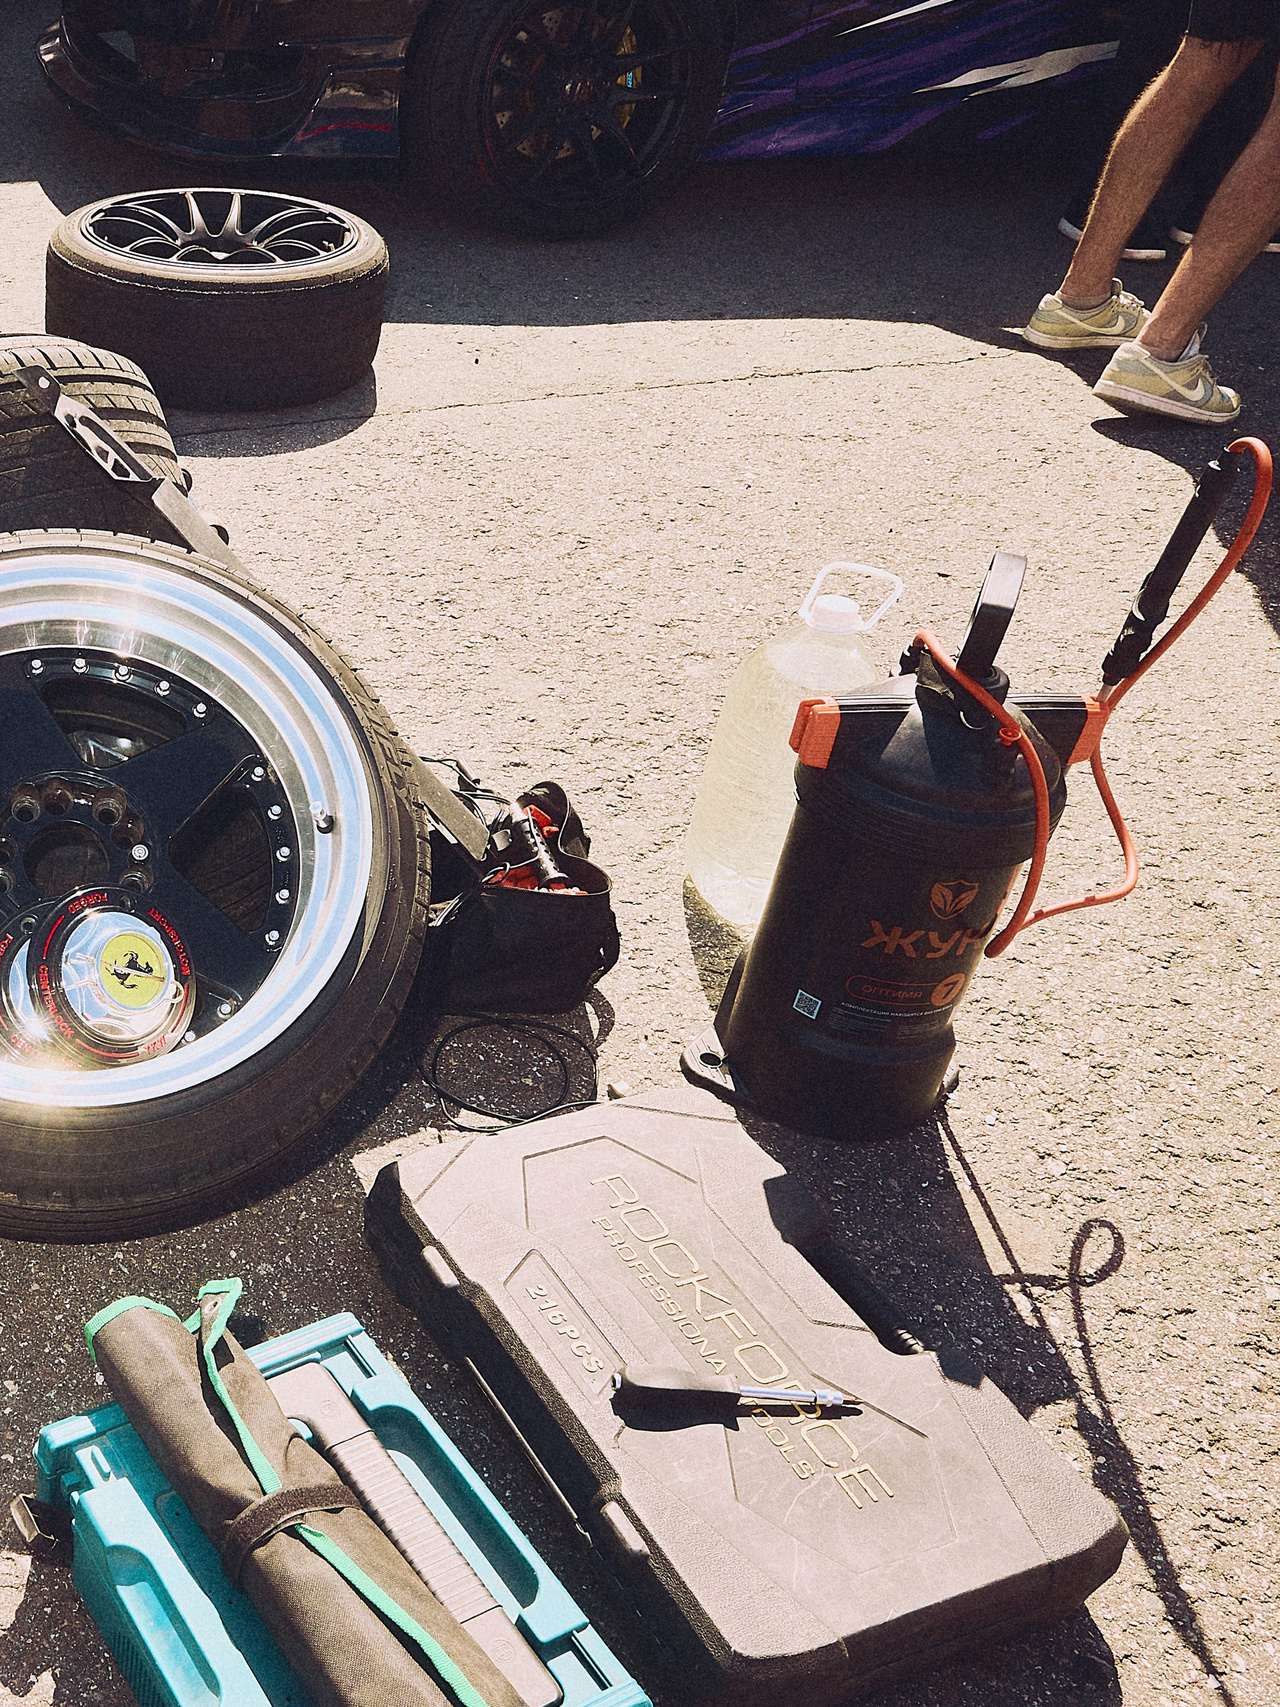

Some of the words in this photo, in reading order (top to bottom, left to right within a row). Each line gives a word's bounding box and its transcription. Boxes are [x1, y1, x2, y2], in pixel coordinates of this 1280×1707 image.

[68, 891, 108, 914] FORGED
[147, 907, 191, 976] MOTORSPORT
[860, 919, 990, 959] ЖУК
[39, 964, 74, 1039] CENTERLOCK
[861, 984, 924, 999] ОПТИМА
[942, 979, 960, 1001] 7
[525, 1284, 605, 1374] 216PCS
[591, 1215, 728, 1375] PROFESSIONA
[590, 1173, 895, 1510] ROCKFORCE
